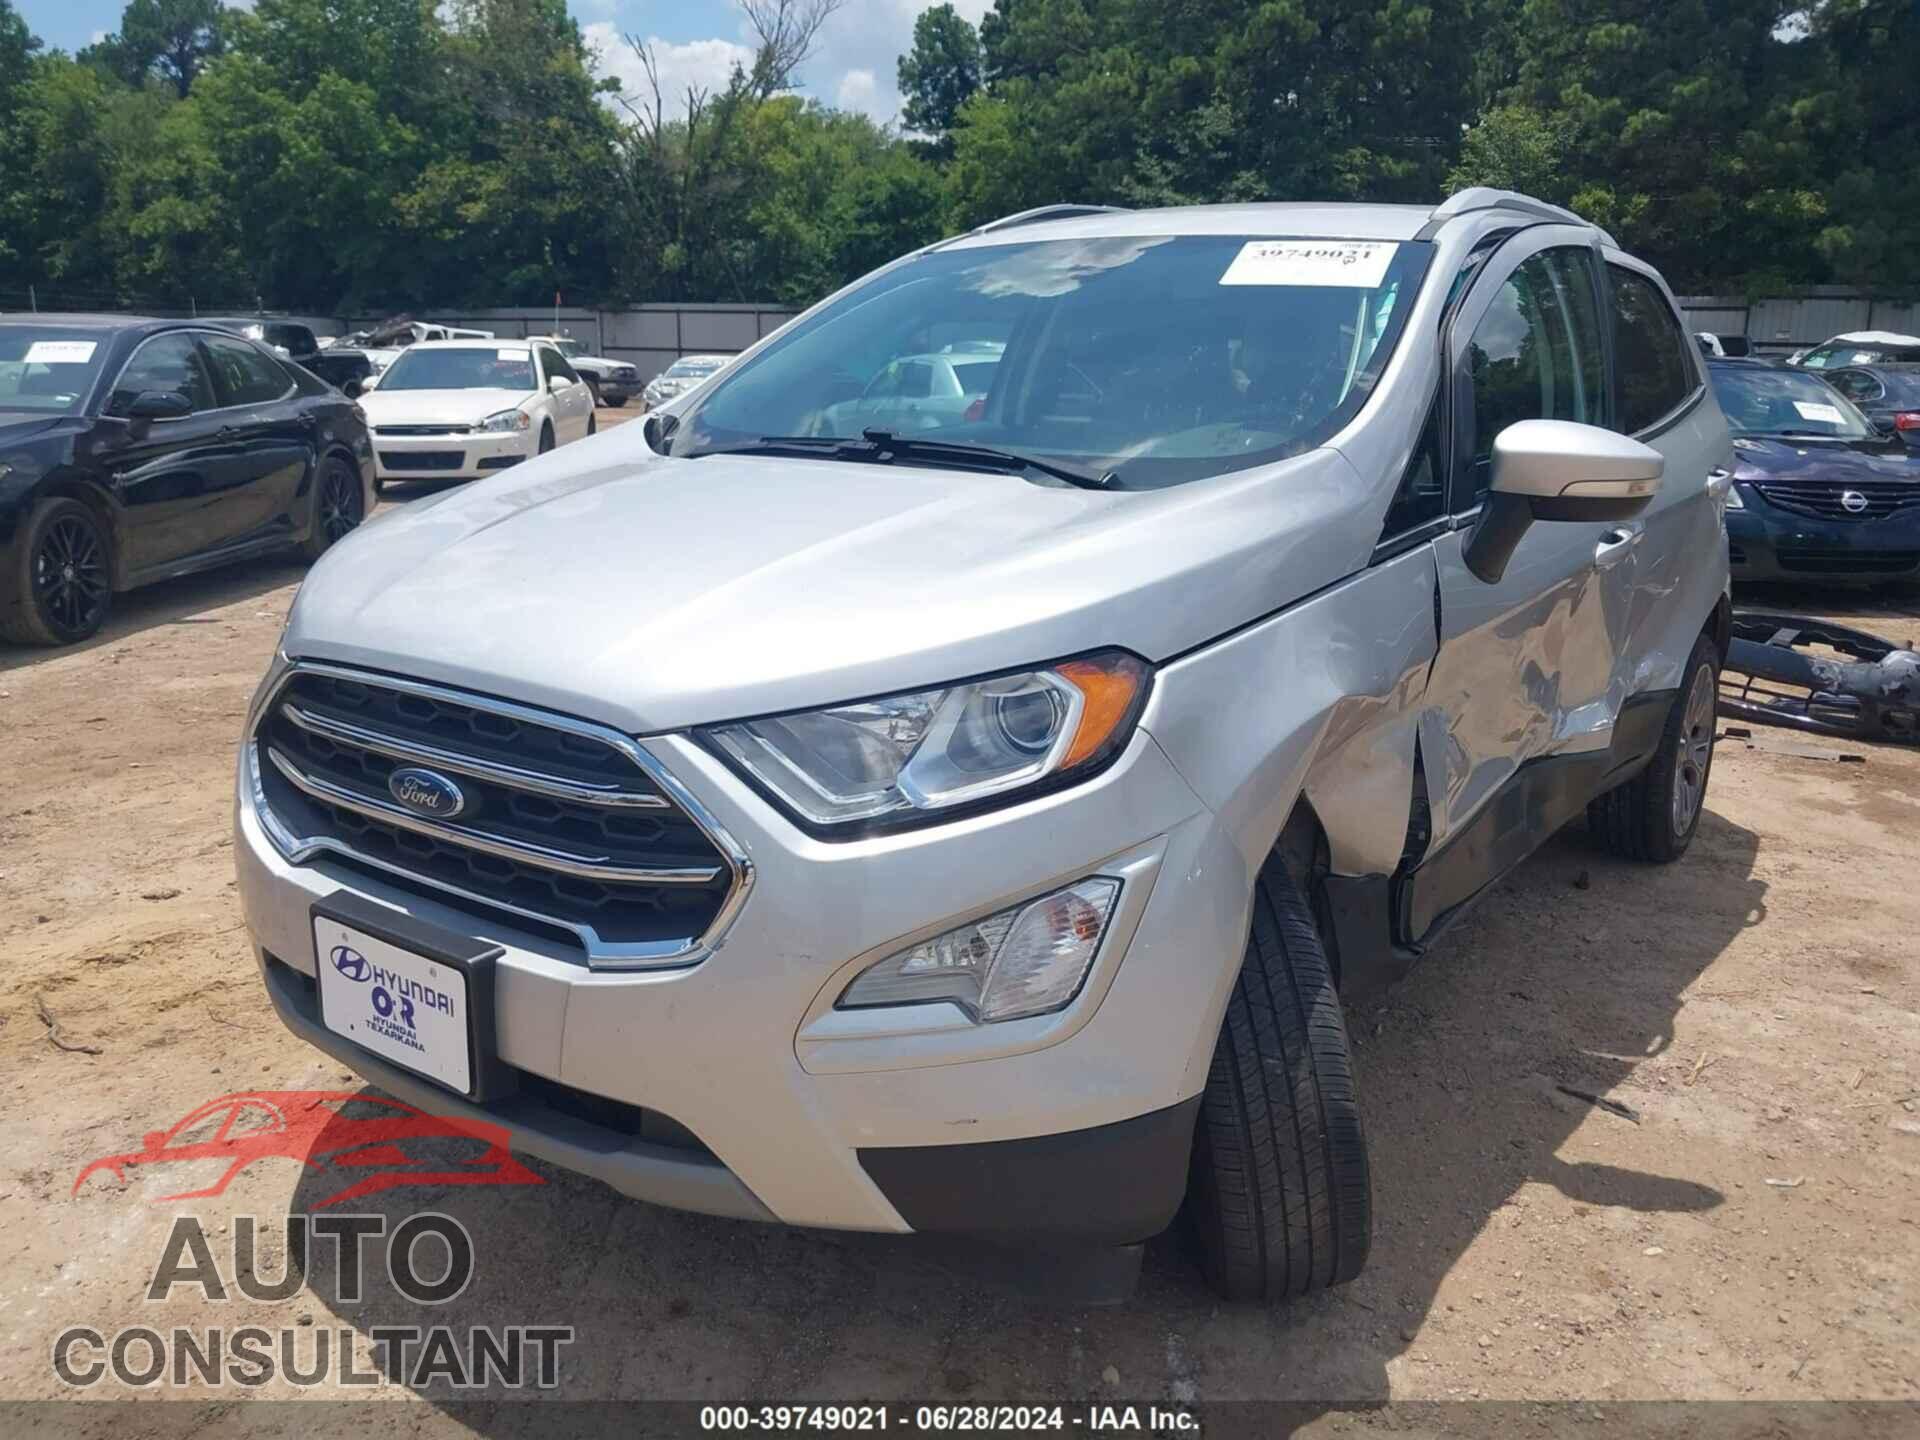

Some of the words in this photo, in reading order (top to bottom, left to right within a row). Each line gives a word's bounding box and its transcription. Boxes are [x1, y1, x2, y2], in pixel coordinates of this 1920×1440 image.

[400, 776, 441, 808] Ford
[373, 965, 455, 1018] HYUNDAI
[366, 1019, 425, 1052] TEXARKANA
[373, 1014, 417, 1040] HYUNDAI
